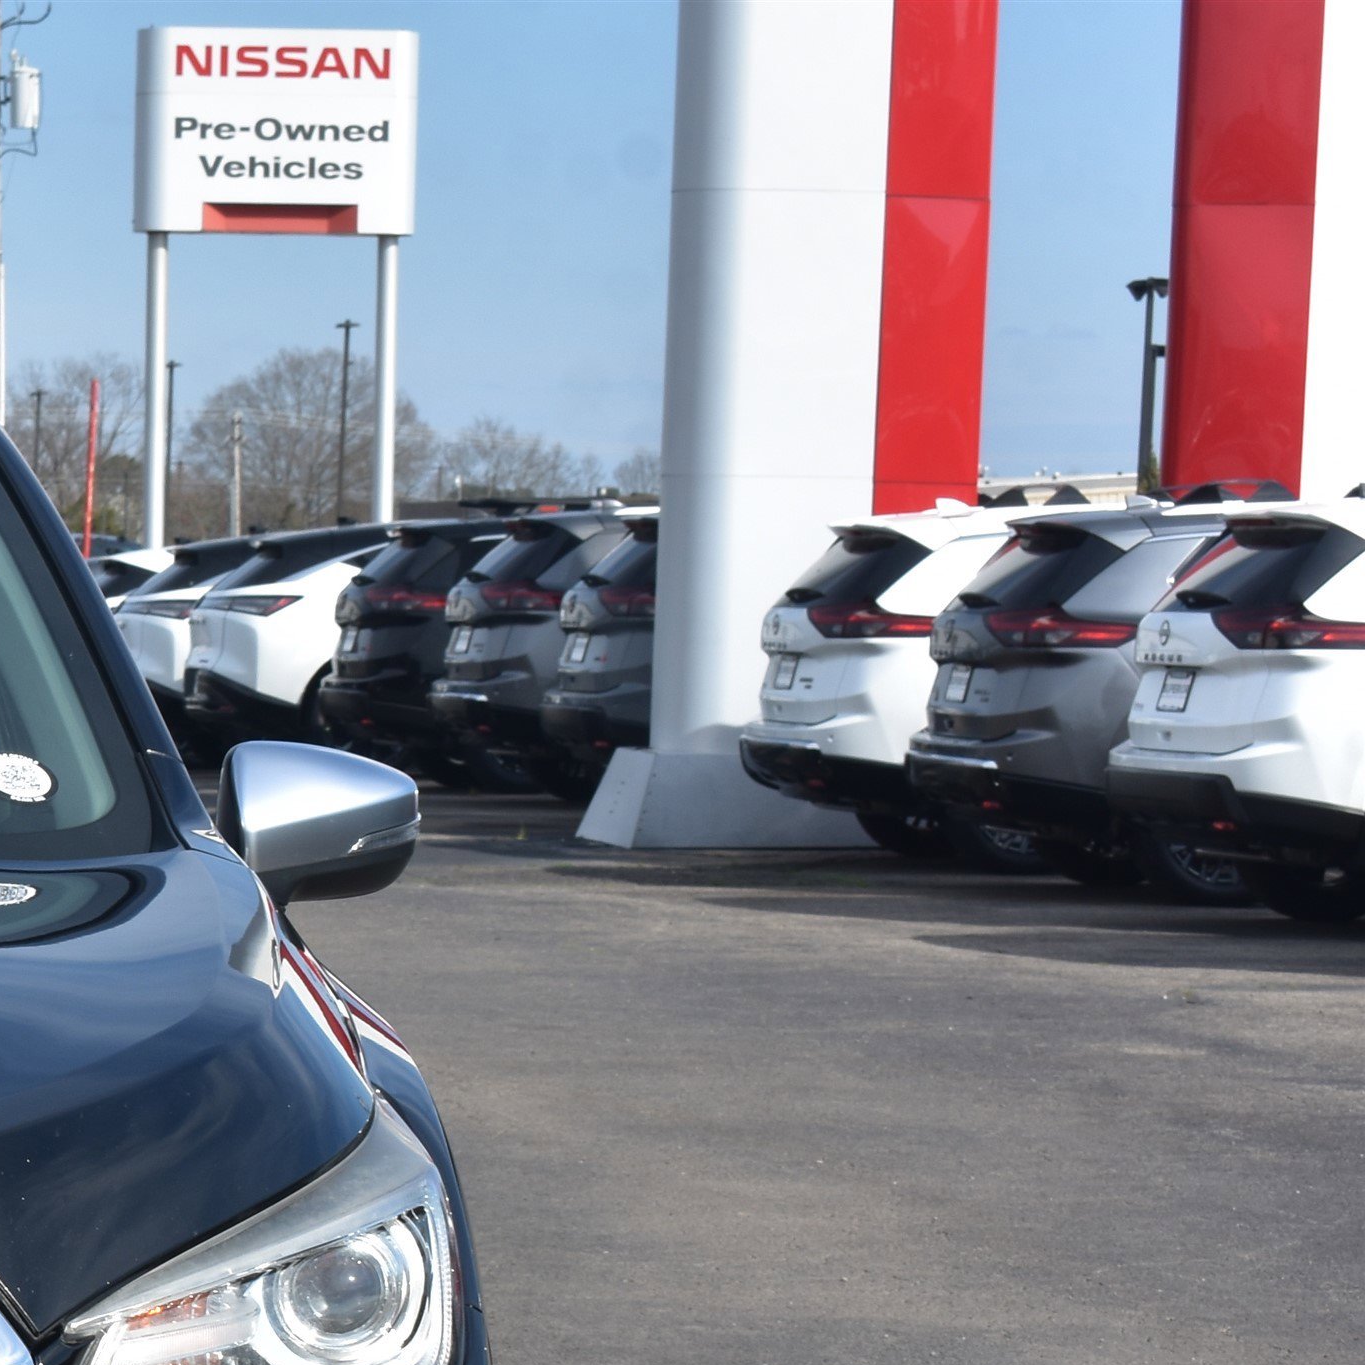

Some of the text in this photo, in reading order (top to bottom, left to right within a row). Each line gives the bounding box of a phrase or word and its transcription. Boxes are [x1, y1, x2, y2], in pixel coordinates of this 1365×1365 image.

[175, 45, 391, 79] NISSAN
[174, 117, 390, 142] Pre-Owned
[199, 155, 364, 180] Vehicles
